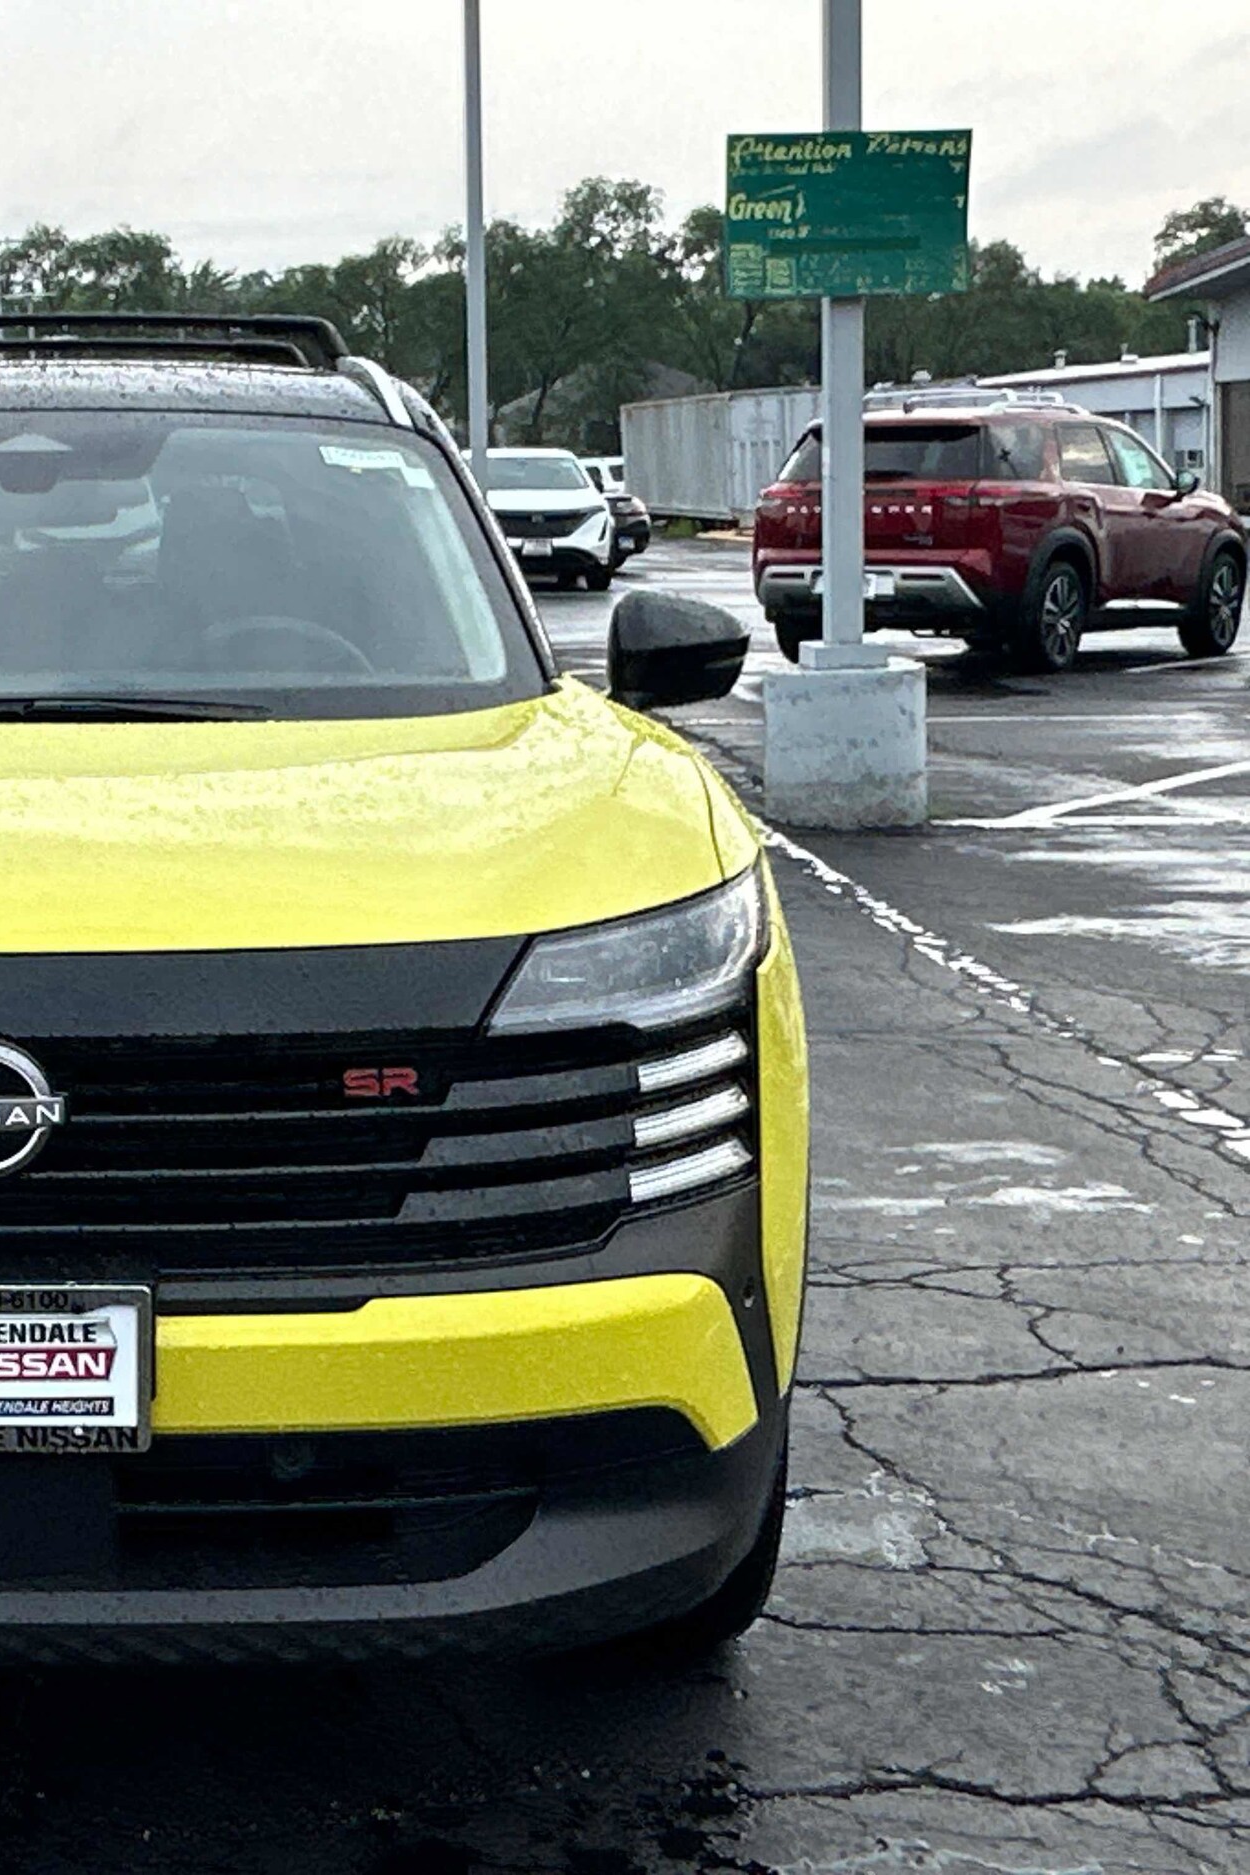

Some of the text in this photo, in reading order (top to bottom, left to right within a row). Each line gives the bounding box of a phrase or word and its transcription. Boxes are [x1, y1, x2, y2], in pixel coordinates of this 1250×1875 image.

[343, 1067, 419, 1096] SR
[51, 1399, 110, 1414] HEIGHTS
[16, 1426, 138, 1449] NISSAN
